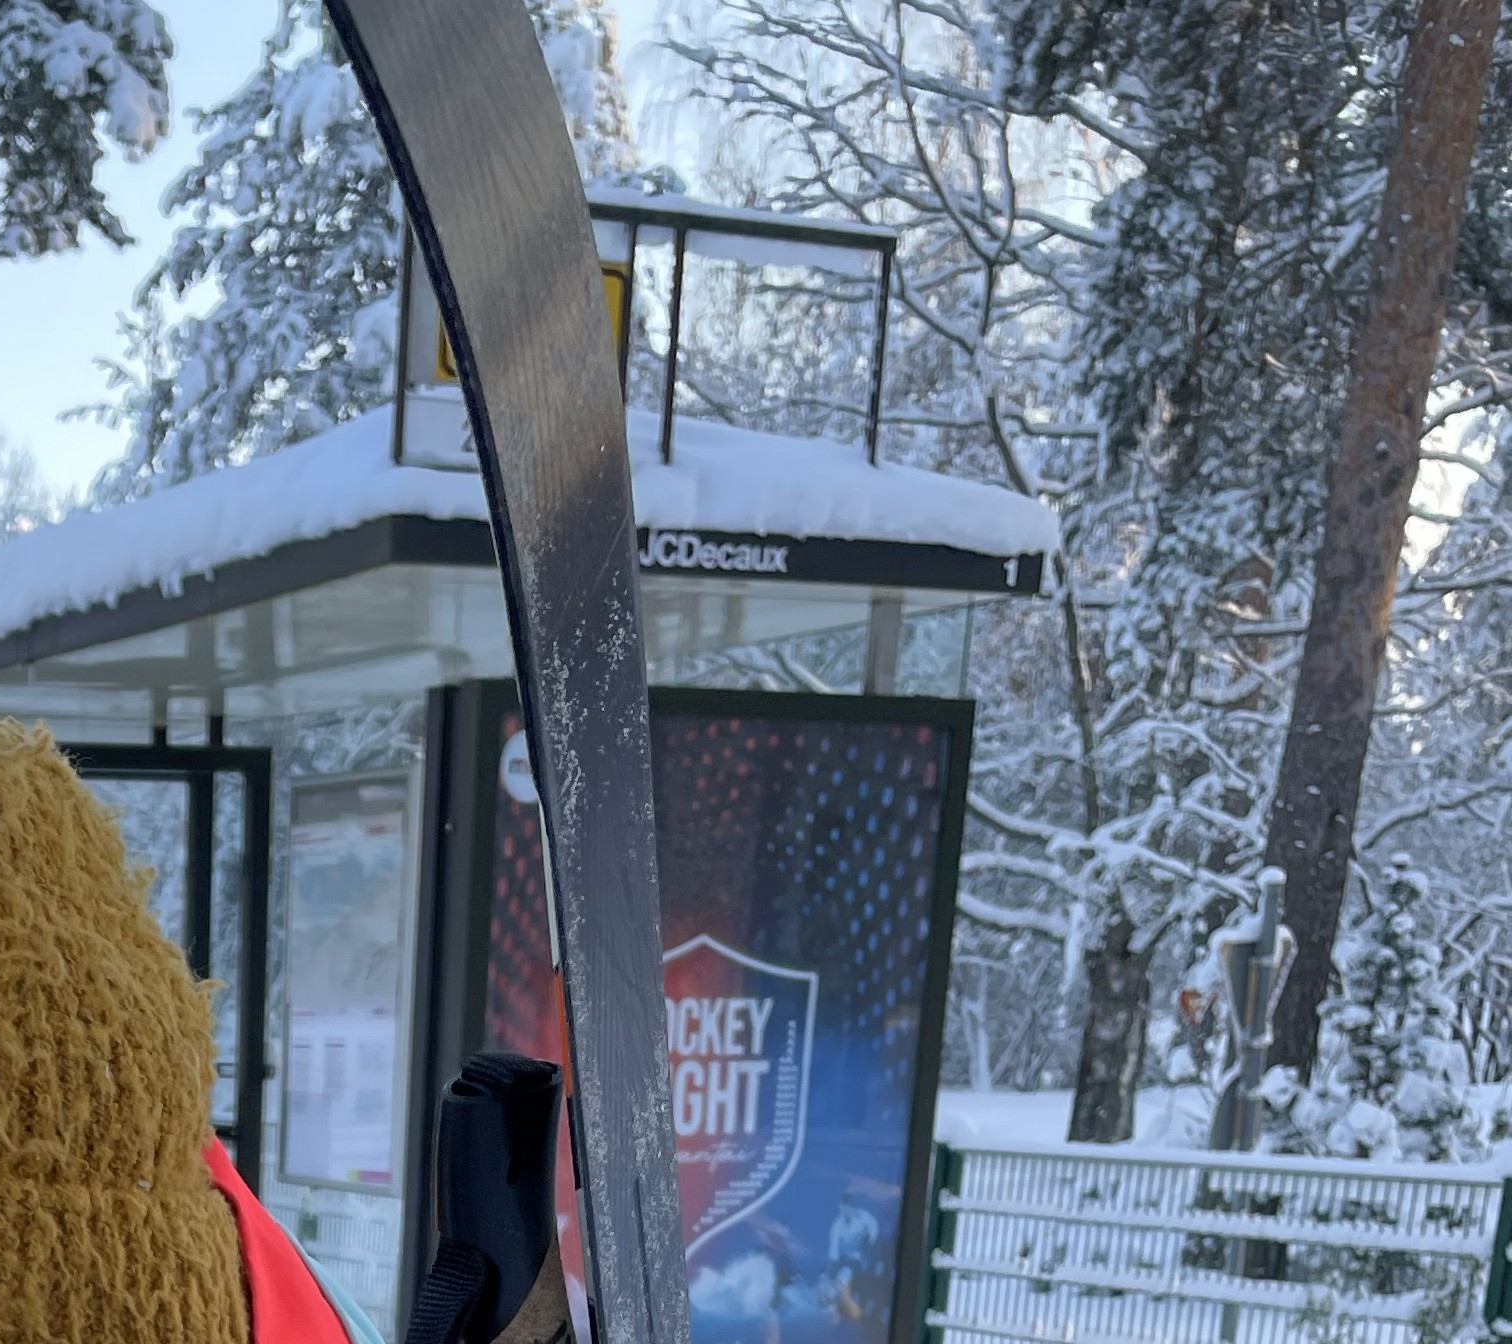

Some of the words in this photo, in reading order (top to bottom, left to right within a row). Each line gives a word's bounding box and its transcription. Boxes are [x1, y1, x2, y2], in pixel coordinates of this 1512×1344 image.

[639, 527, 788, 573] JCDecaux
[1003, 559, 1019, 587] 1
[670, 1059, 770, 1136] GHT
